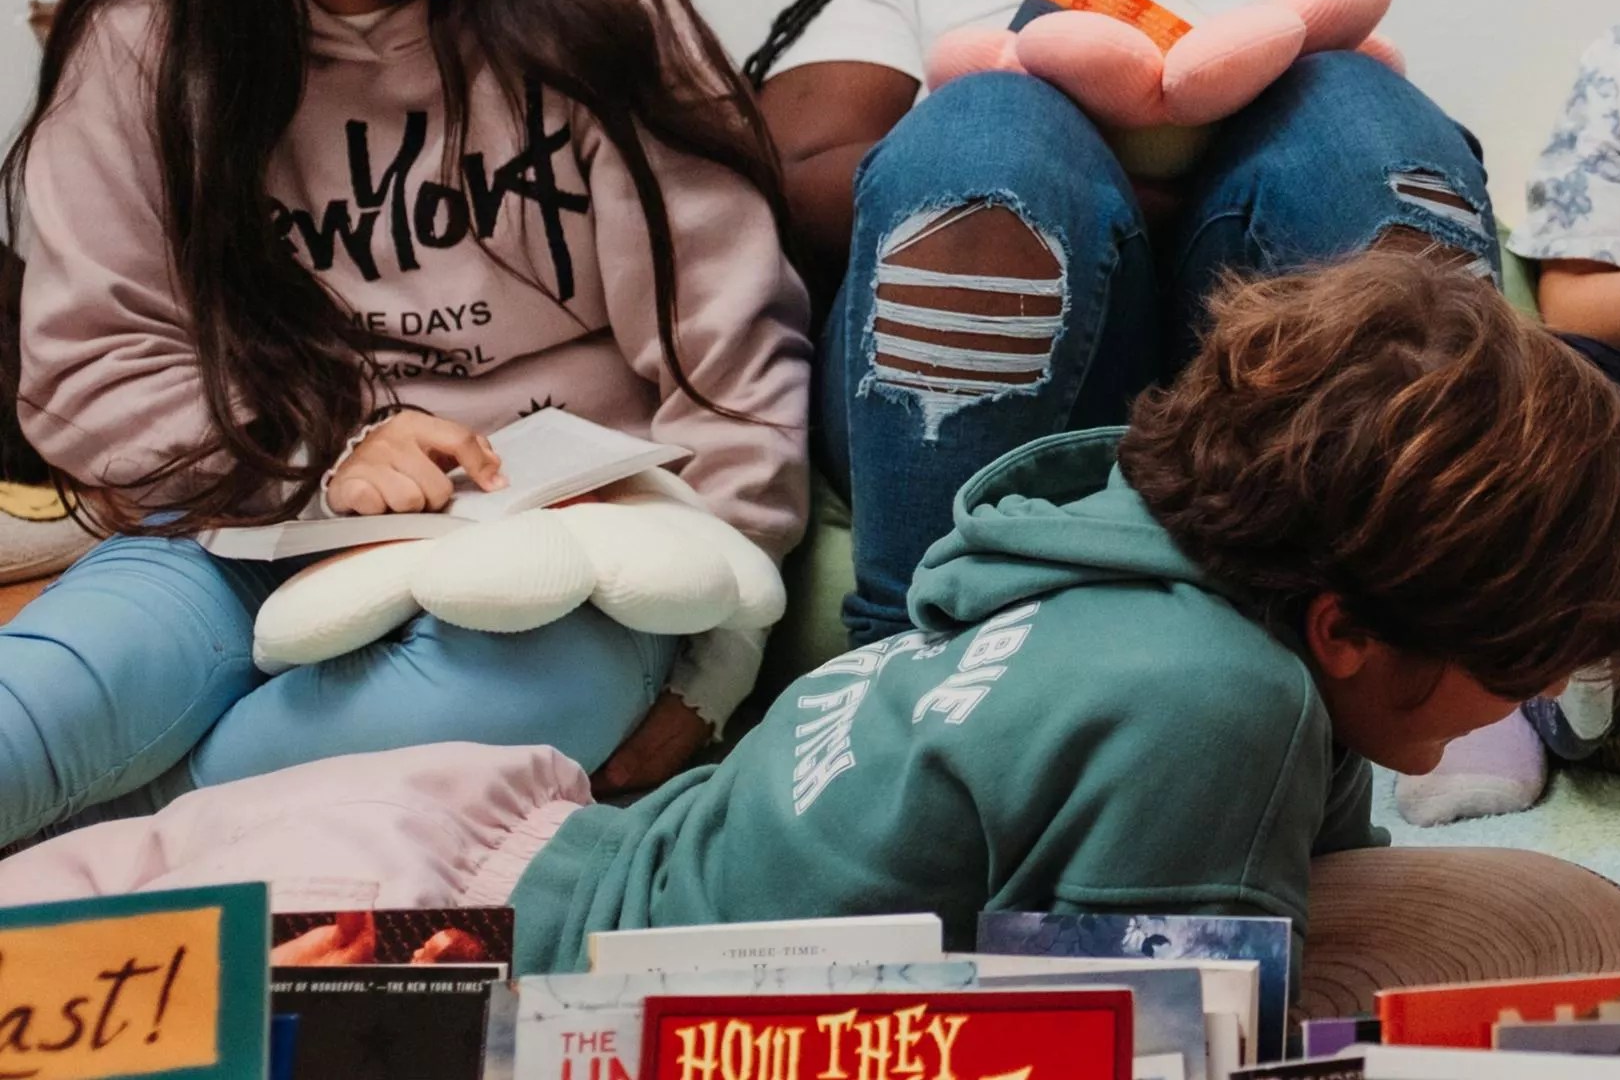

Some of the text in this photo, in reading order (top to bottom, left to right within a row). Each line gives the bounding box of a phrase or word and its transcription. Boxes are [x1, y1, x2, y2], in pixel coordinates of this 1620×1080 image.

[401, 301, 492, 336] DAYS
[295, 982, 309, 993] OF
[406, 982, 426, 993] NEW
[430, 982, 453, 993] YORK
[456, 982, 483, 993] TIMES
[562, 1032, 617, 1053] THE
[676, 1004, 969, 1080] HOW THEY
